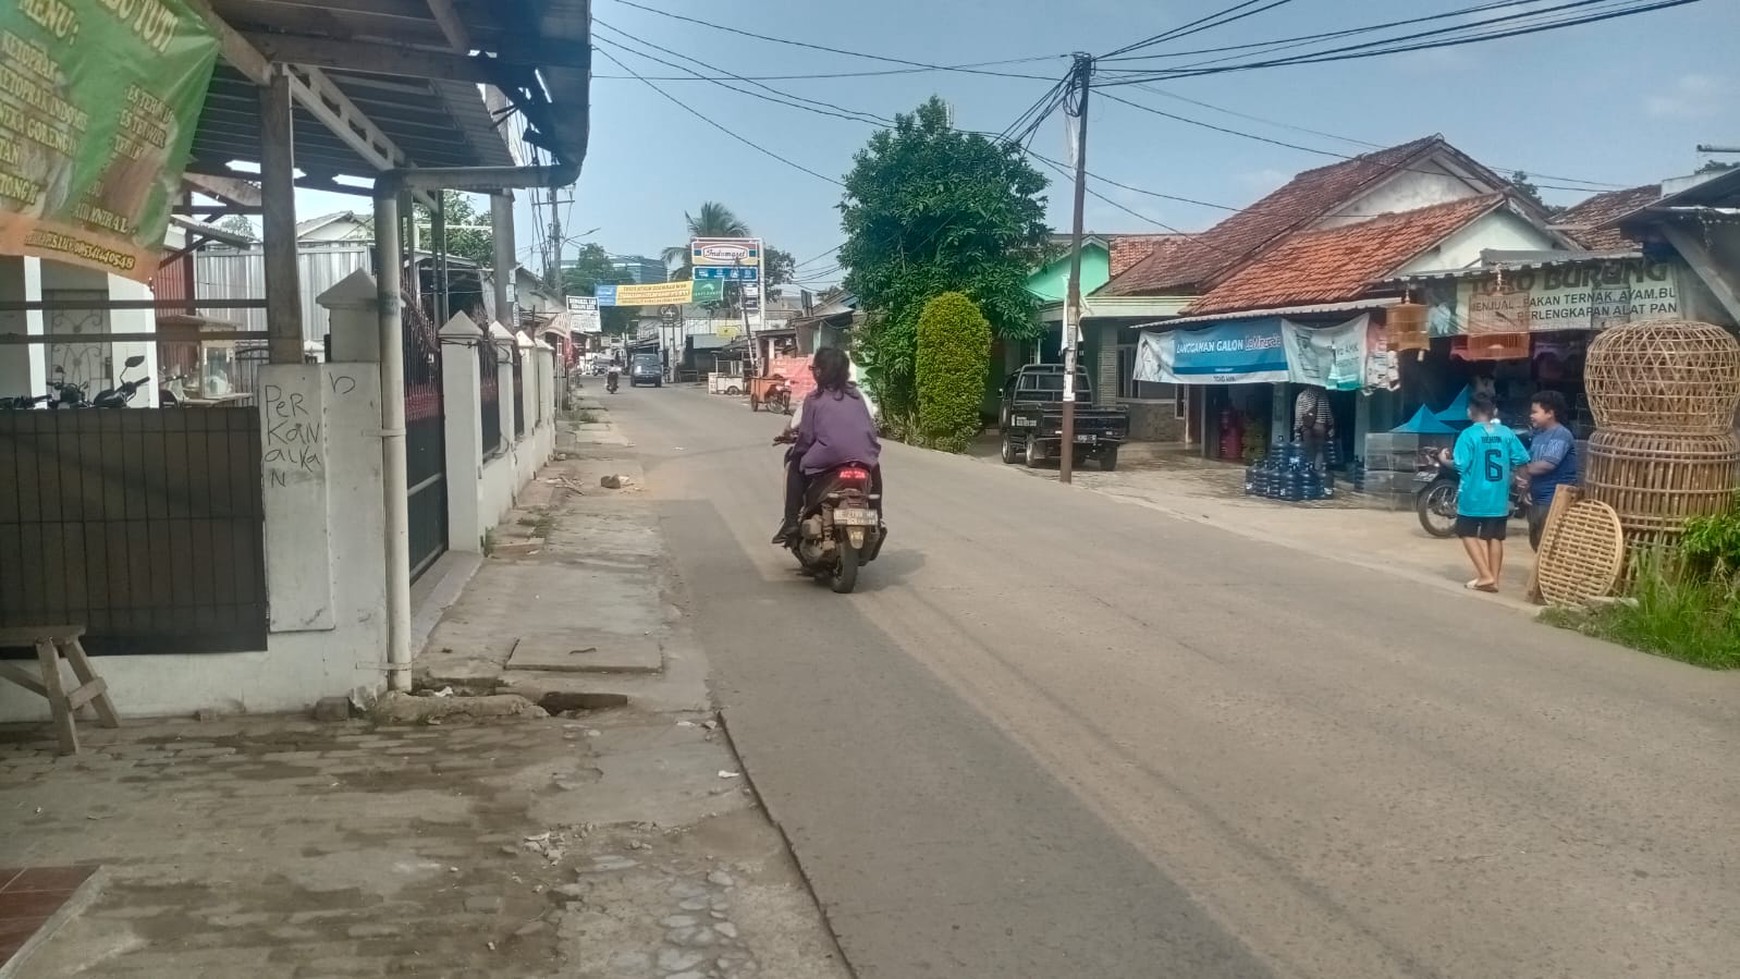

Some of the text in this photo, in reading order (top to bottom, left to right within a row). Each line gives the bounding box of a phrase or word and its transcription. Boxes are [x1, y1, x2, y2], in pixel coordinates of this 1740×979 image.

[1216, 338, 1244, 352] GALON
[1484, 449, 1503, 482] 6
[270, 467, 287, 489] N
